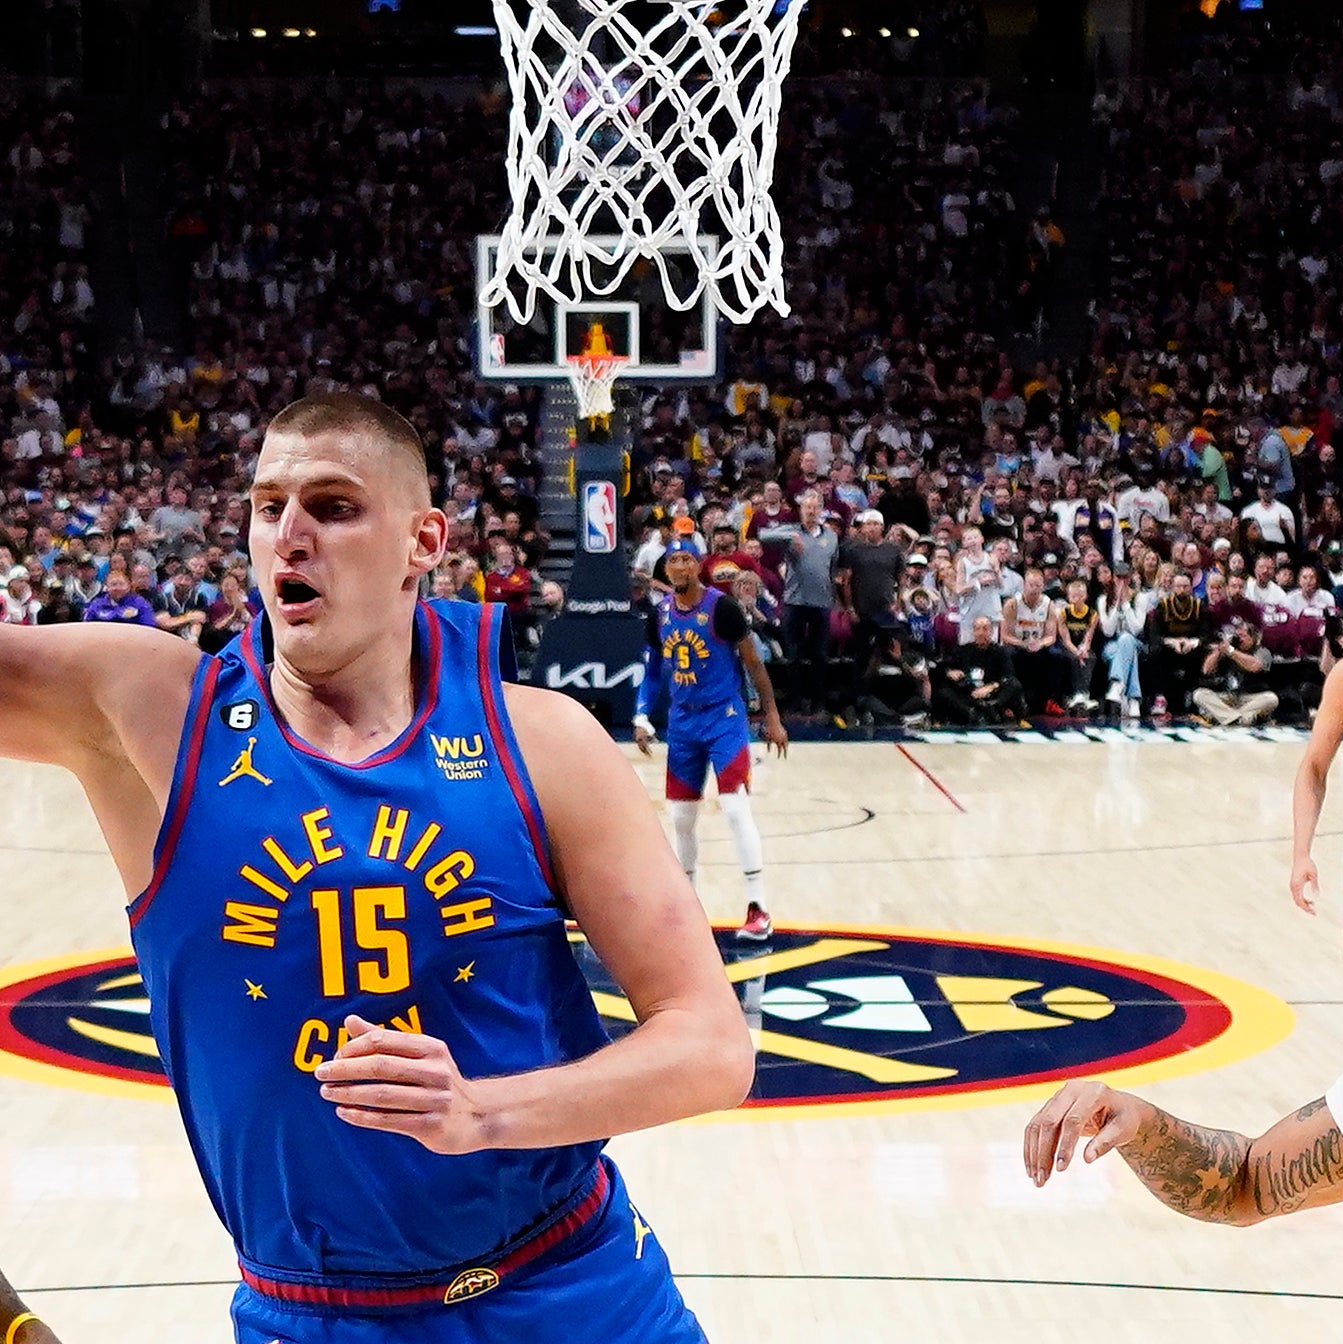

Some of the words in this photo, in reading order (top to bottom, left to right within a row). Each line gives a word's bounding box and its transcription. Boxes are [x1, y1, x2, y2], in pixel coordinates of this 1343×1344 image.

[567, 601, 606, 613] Google
[607, 600, 631, 612] Pixel
[678, 645, 690, 669] 5
[229, 702, 254, 730] 6
[429, 733, 484, 759] WU
[435, 757, 489, 770] Western
[445, 769, 483, 780] Union
[222, 804, 345, 948] MILE
[367, 804, 496, 937] HIGH
[310, 884, 413, 998] 15
[293, 1004, 424, 1074] CY
